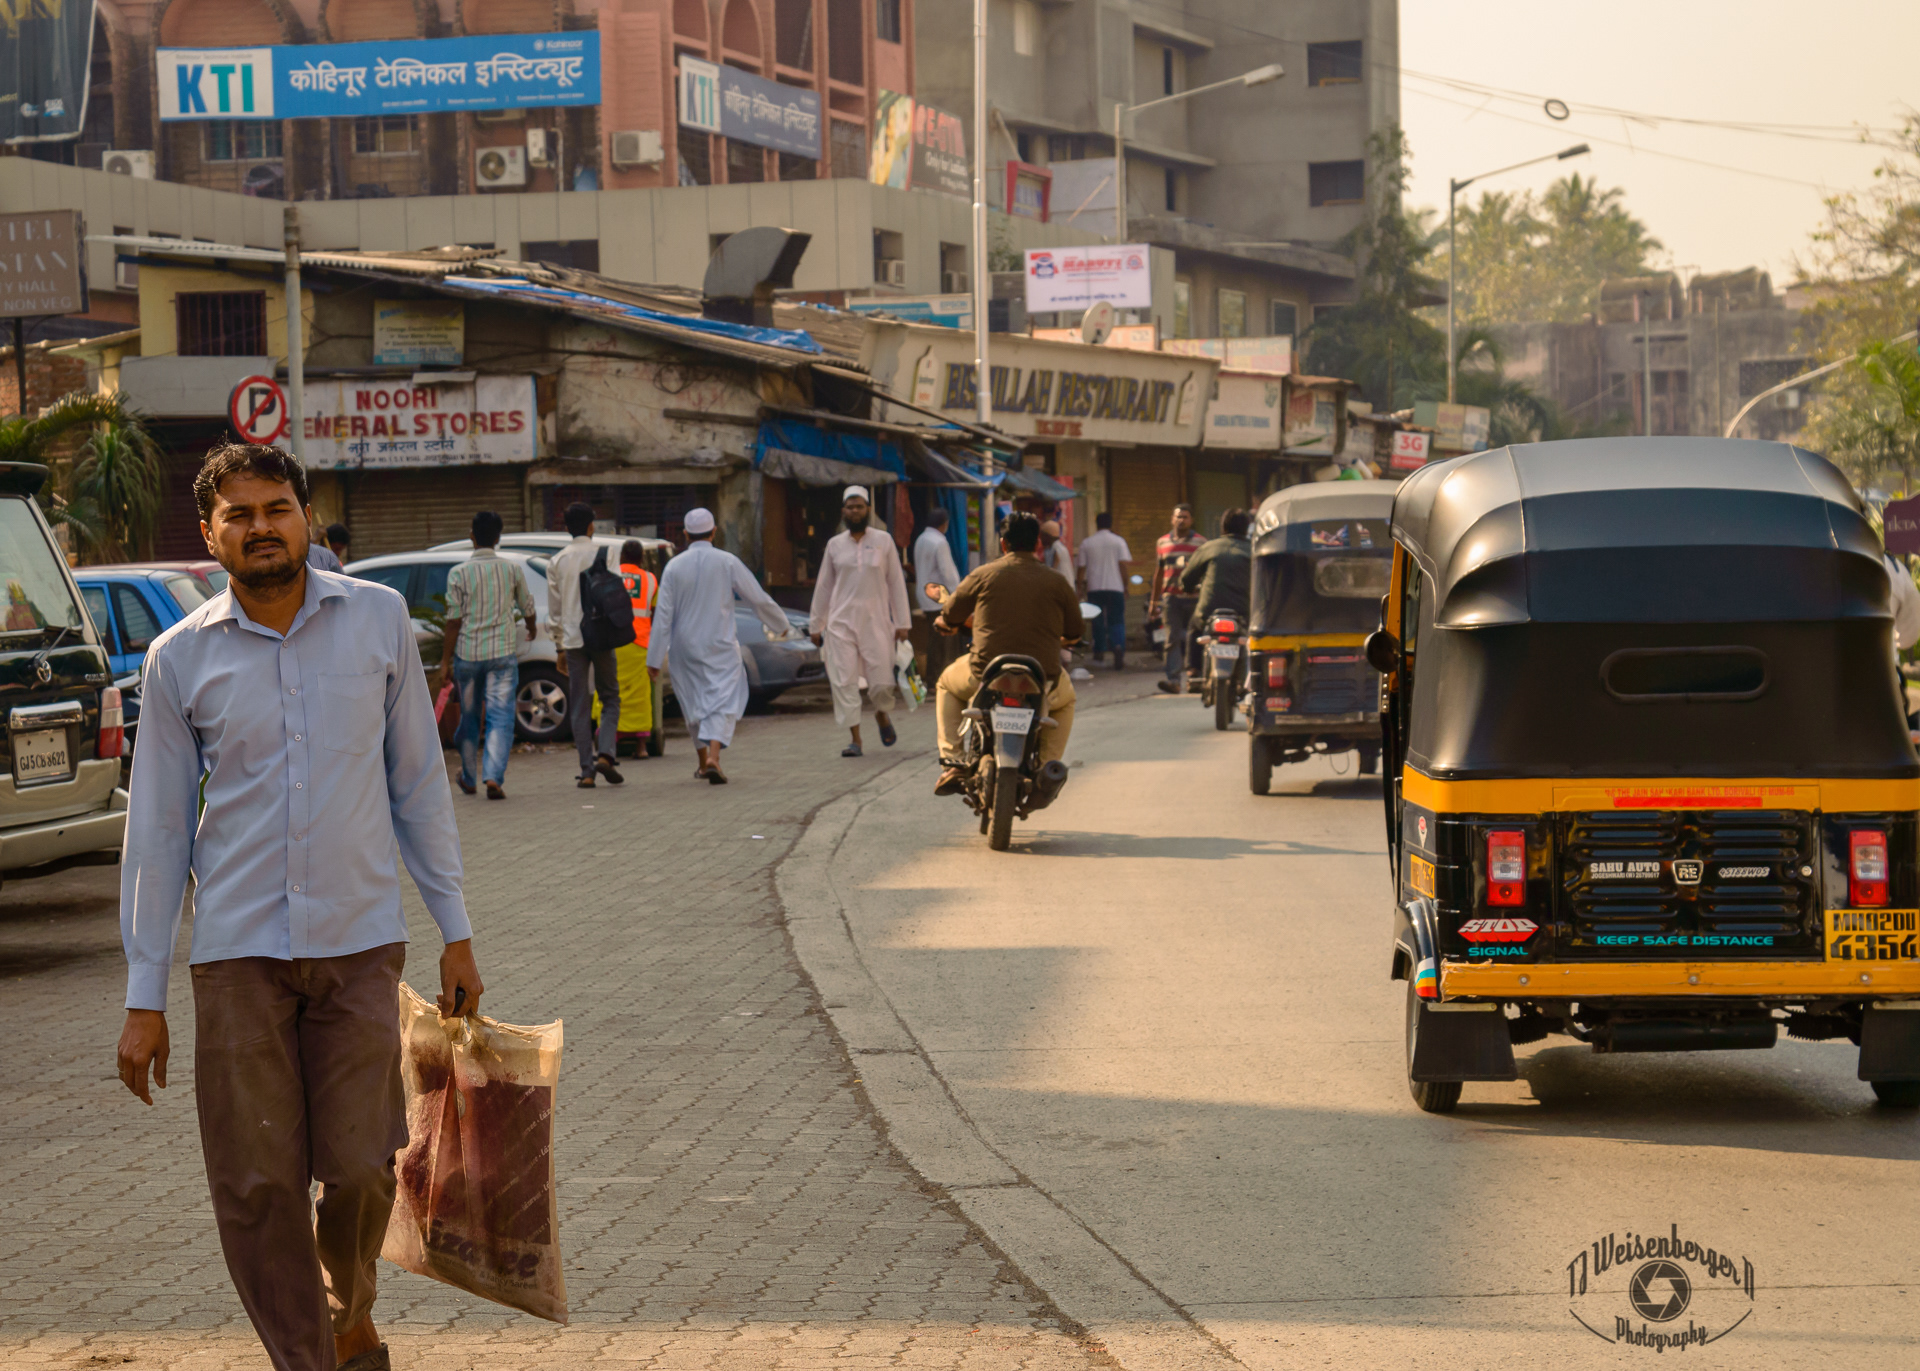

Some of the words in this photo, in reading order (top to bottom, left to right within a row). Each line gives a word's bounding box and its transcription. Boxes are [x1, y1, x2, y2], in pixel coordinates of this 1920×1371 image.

[288, 59, 368, 97] कोहिनूर
[373, 56, 468, 88] टेक्निकल
[176, 63, 254, 114] KTI
[686, 71, 714, 127] KTI
[18, 279, 57, 293] HALL
[4, 299, 37, 312] NON
[41, 295, 73, 310] VEG
[355, 388, 438, 412] NOORI
[942, 362, 1054, 414] BISILLAH
[1053, 369, 1175, 422] RESTAURANT
[413, 410, 526, 435] STORES
[1400, 434, 1423, 452] 3G
[1590, 861, 1624, 873] SAHU
[1627, 861, 1661, 873] AUTO
[1679, 867, 1698, 879] RE
[1457, 918, 1539, 938] STOP
[1597, 935, 1639, 946] KEEP
[1642, 935, 1689, 946] SAFE
[1691, 935, 1774, 946] DISTANCE
[1830, 934, 1919, 961] 4354
[1467, 946, 1529, 957] SIGNAL
